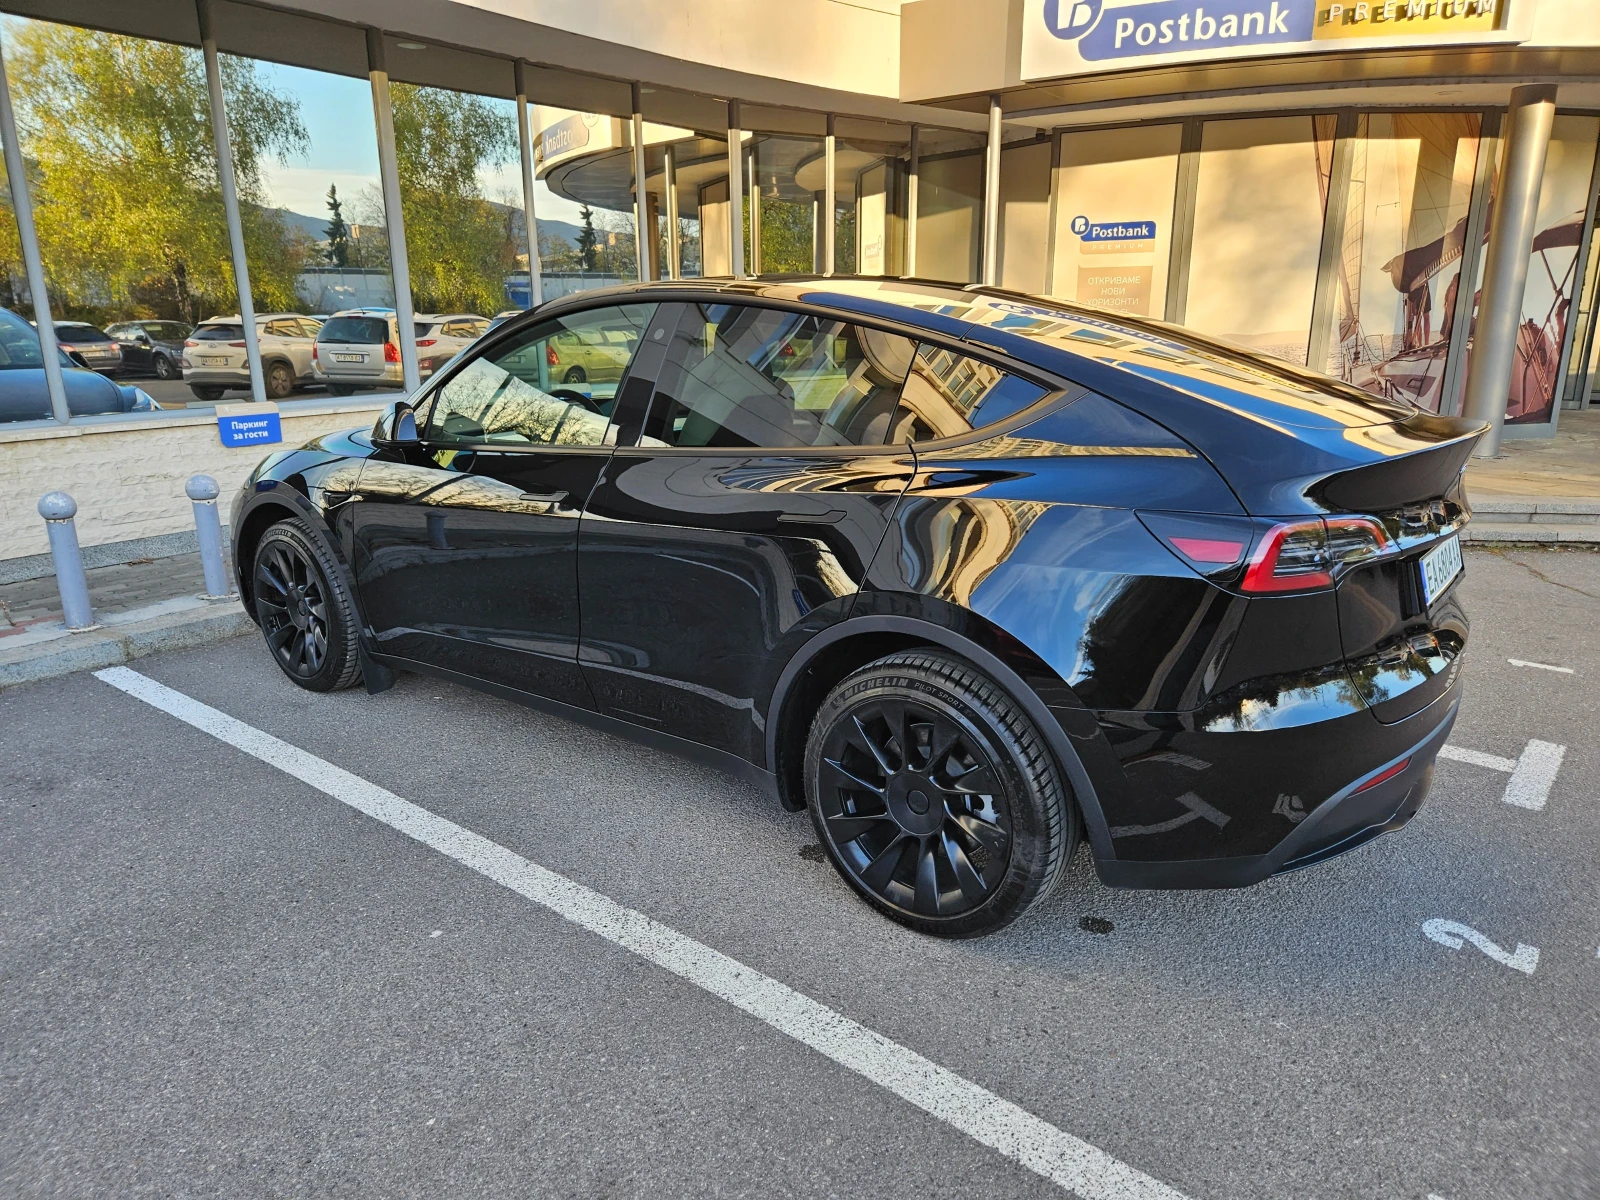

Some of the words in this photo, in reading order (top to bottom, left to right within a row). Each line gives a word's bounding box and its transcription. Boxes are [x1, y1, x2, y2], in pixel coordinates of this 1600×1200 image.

[1327, 0, 1496, 22] PREMIUM
[1114, 2, 1290, 49] Postbank
[1092, 224, 1149, 238] Postbank
[1087, 276, 1141, 285] ОТКРИВАМЕ
[1101, 287, 1126, 295] НОВИ
[1087, 298, 1139, 306] ХОРИЗОНТИ
[231, 421, 268, 430] Паркинг
[244, 431, 268, 439] гости
[845, 678, 909, 700] MICHELIN
[914, 682, 936, 694] PILOT
[937, 691, 964, 710] SPORT
[1422, 918, 1541, 975] 2
